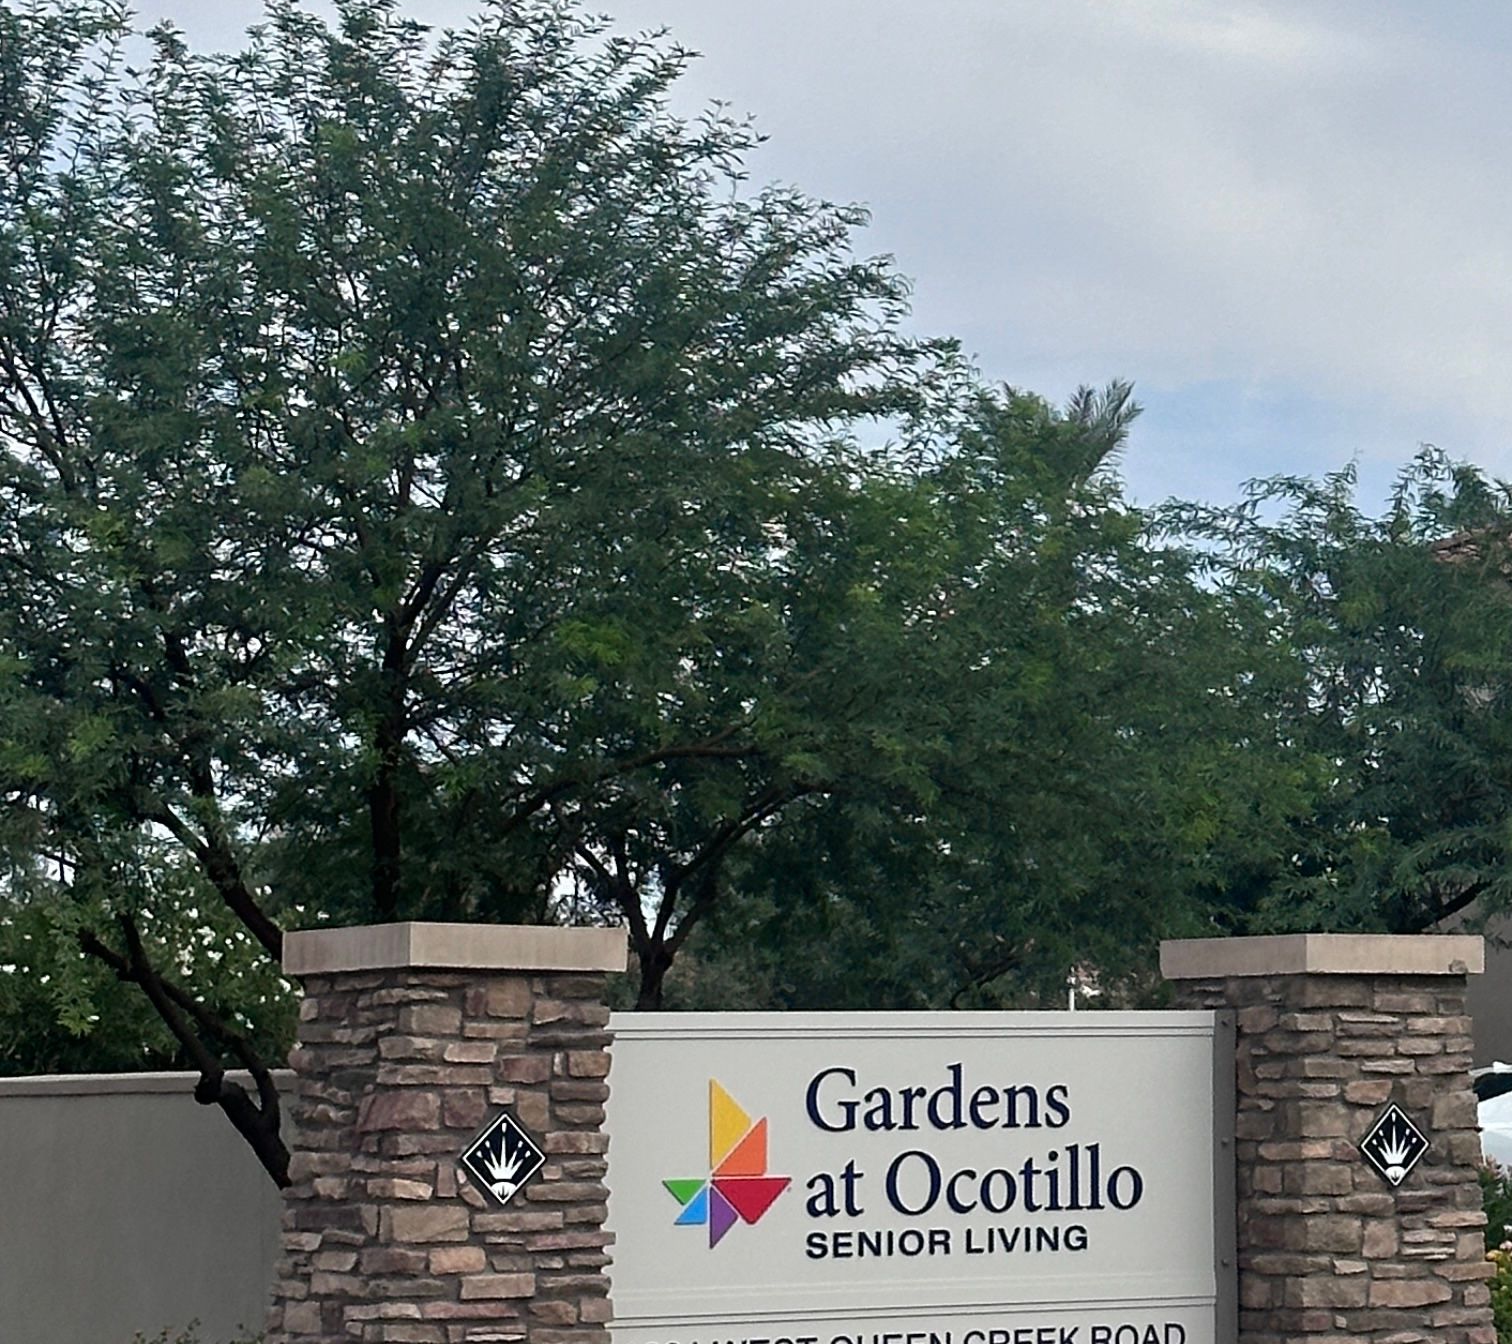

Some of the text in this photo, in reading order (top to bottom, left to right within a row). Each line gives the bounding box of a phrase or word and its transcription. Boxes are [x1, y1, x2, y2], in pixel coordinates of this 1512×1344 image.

[805, 1062, 1070, 1133] Gardens
[805, 1142, 1144, 1219] at Ocotillo
[805, 1224, 1088, 1260] SENIOR LIVING
